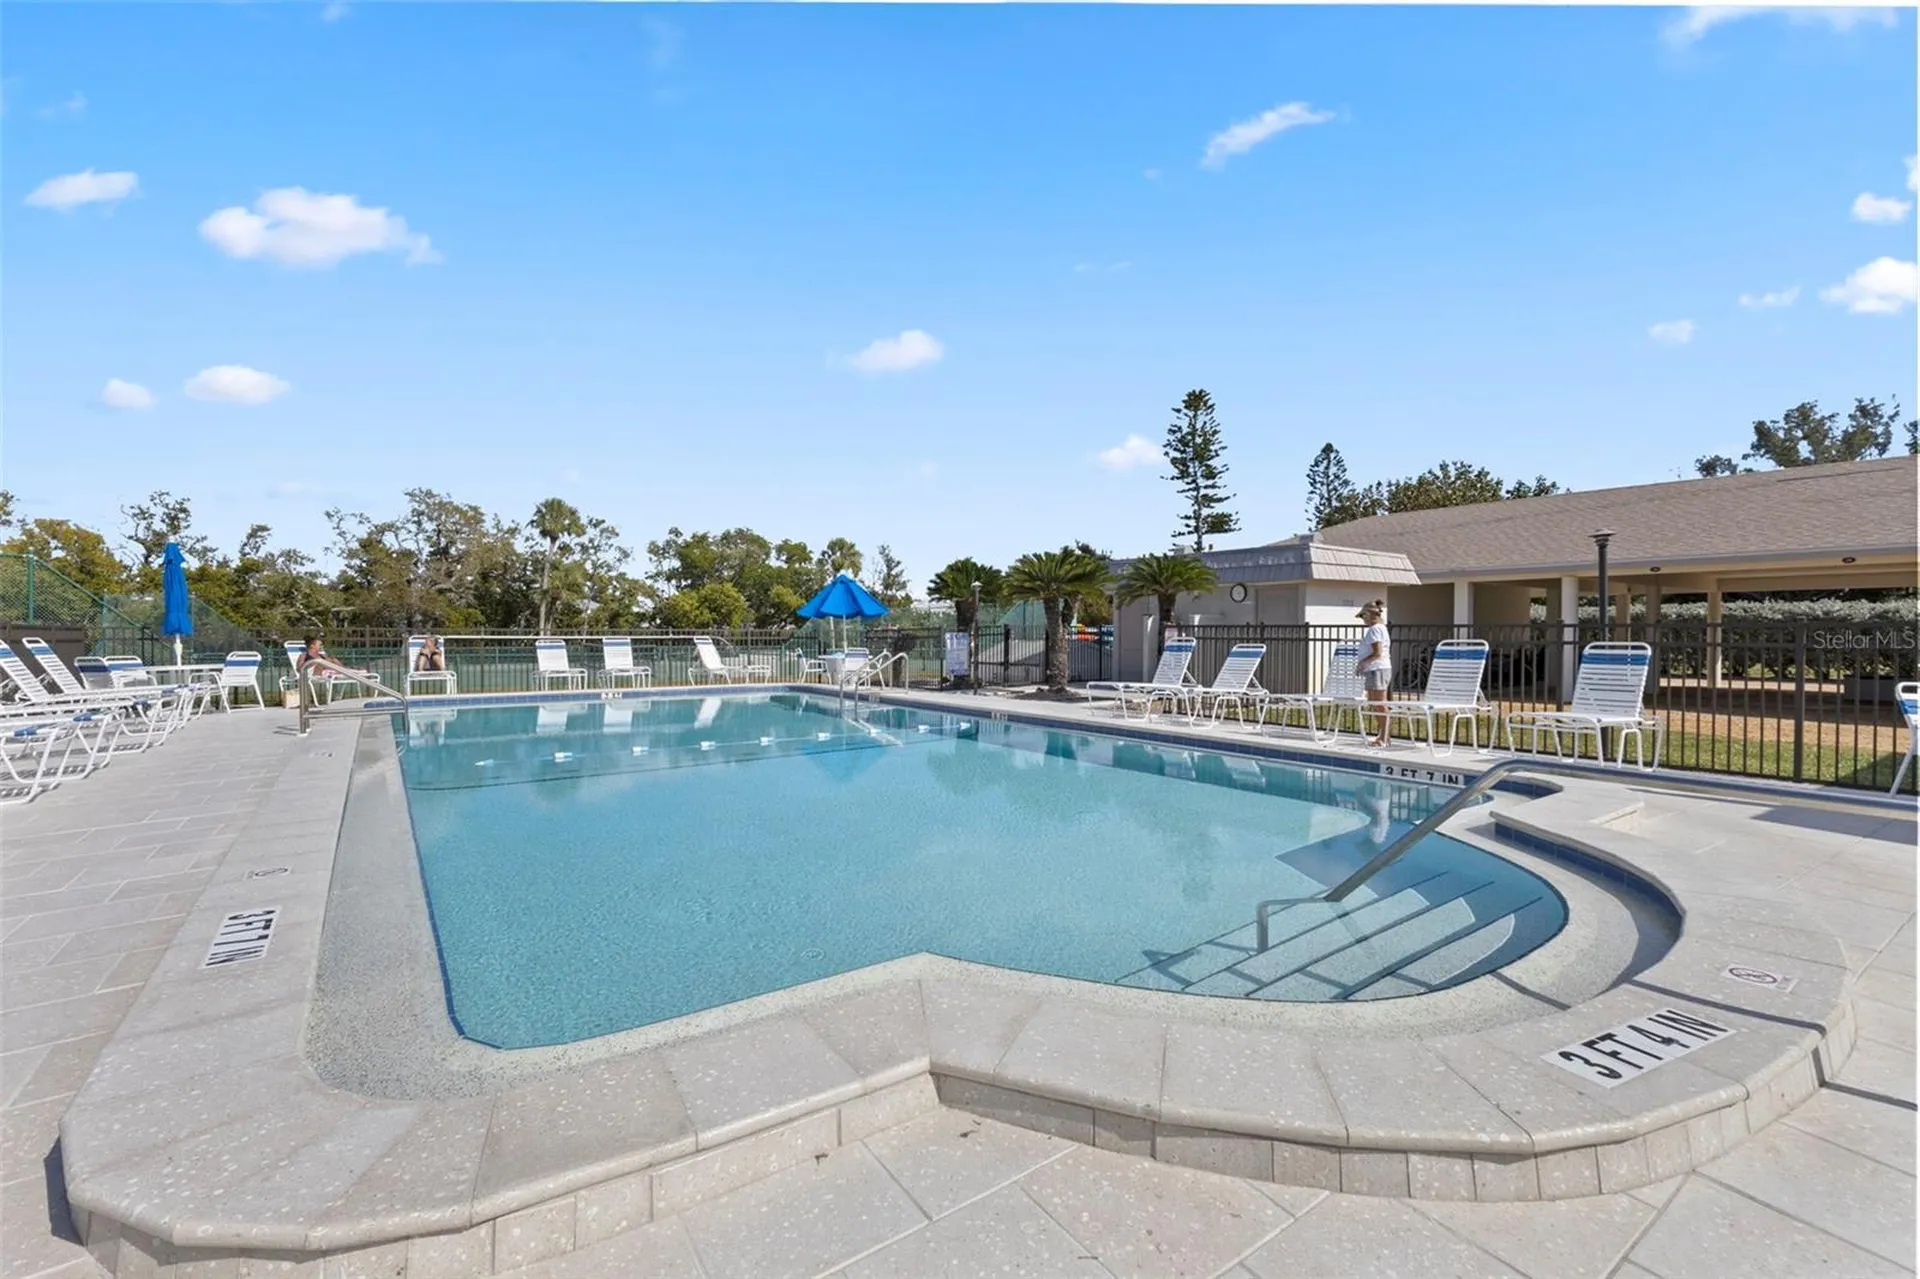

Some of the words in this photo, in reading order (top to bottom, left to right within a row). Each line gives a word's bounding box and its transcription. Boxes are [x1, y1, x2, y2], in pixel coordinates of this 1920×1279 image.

[1385, 766, 1394, 776] 3
[1400, 768, 1418, 778] FT
[1426, 771, 1435, 782] 7
[1442, 773, 1459, 785] IN
[220, 917, 273, 936] FT
[228, 910, 276, 920] 3
[206, 945, 265, 966] IN
[1627, 1024, 1692, 1049] 4
[1646, 1009, 1729, 1042] IN
[1581, 1032, 1664, 1070] FT
[1557, 1050, 1623, 1080] 3
